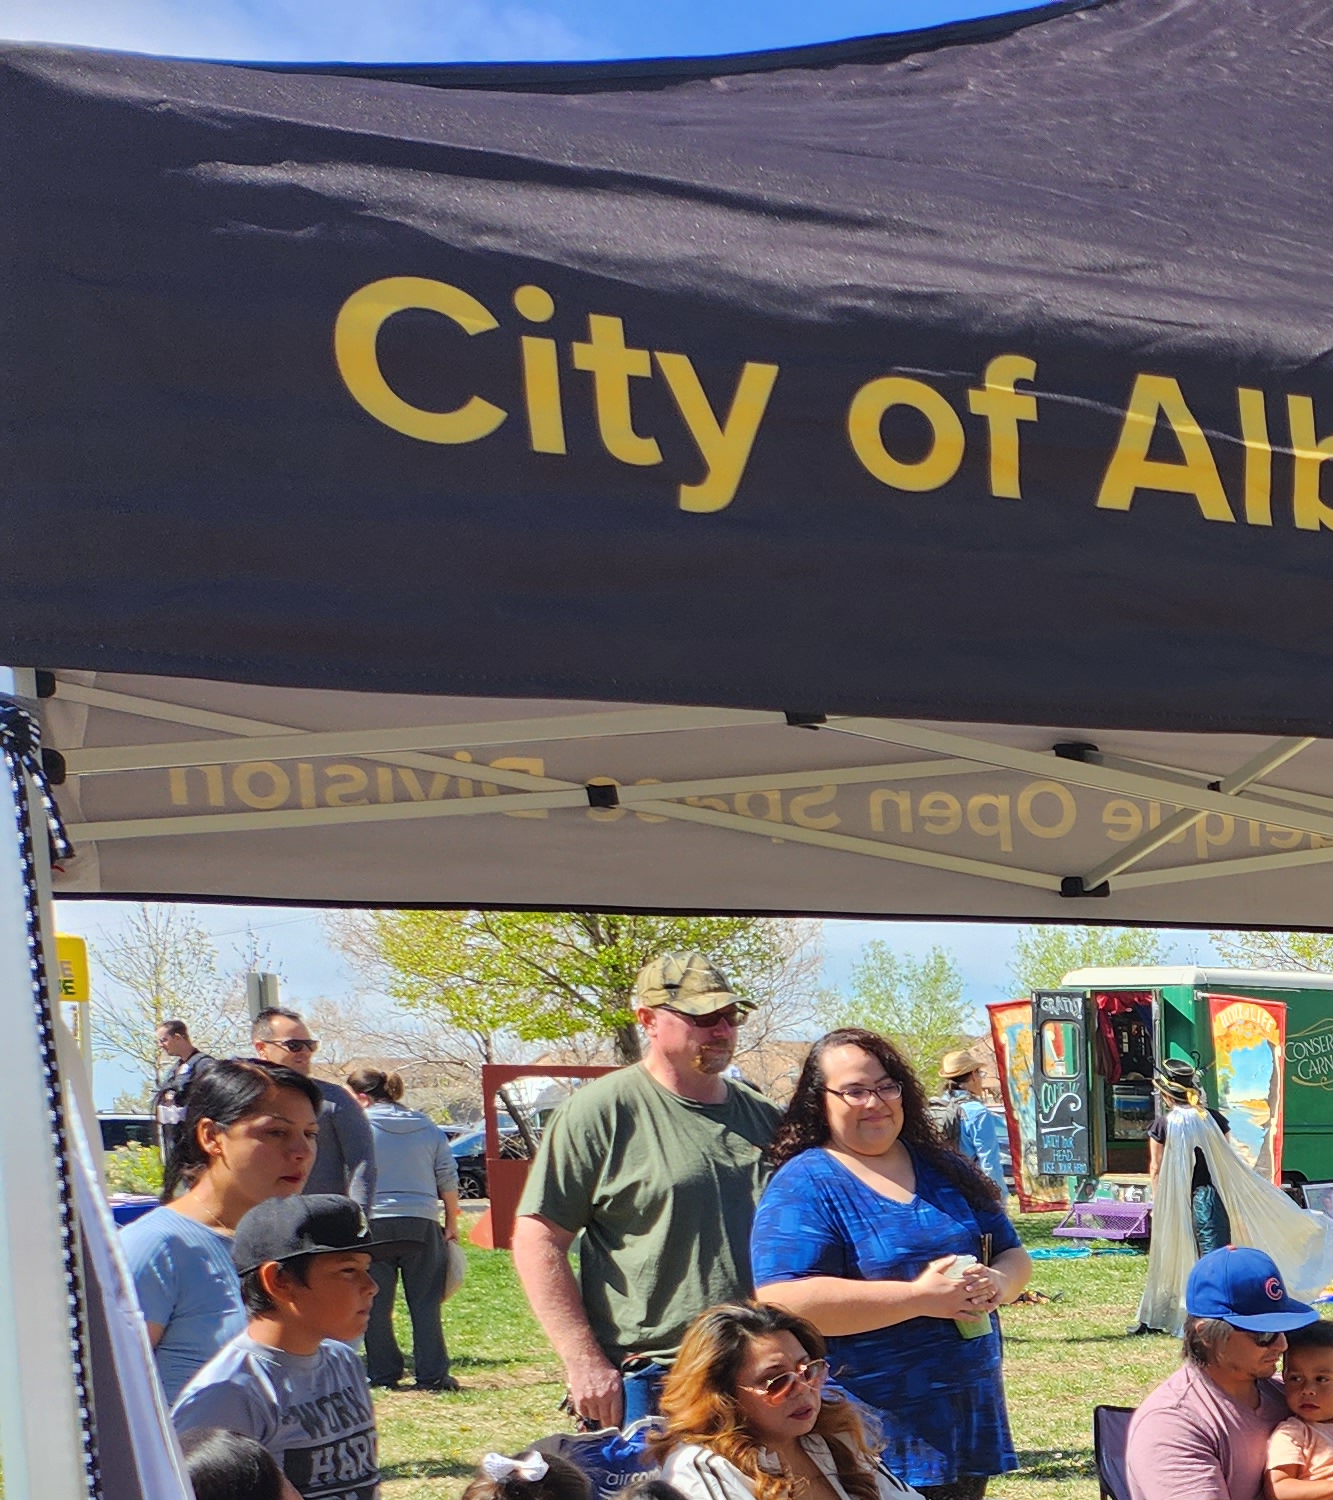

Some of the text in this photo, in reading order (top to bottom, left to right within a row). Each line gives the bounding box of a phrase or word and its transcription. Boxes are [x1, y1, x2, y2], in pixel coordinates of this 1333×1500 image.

[332, 276, 779, 513] City
[847, 354, 1038, 499] of
[285, 1386, 372, 1440] WORK
